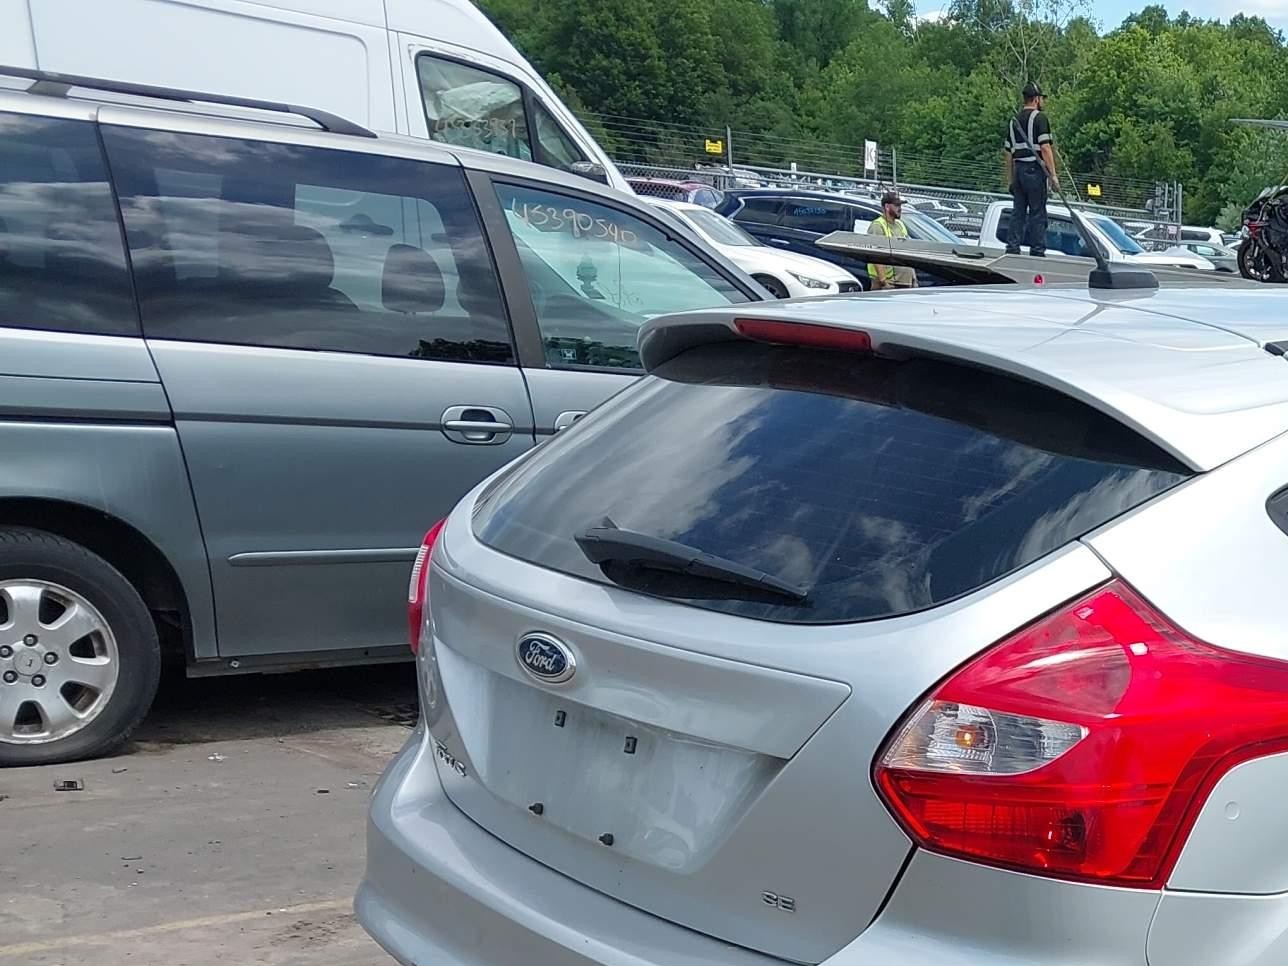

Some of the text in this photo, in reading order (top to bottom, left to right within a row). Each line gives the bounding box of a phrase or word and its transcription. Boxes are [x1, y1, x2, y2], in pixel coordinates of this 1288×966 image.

[511, 198, 638, 244] 45390540
[525, 640, 558, 671] Ford
[760, 890, 796, 913] SE
